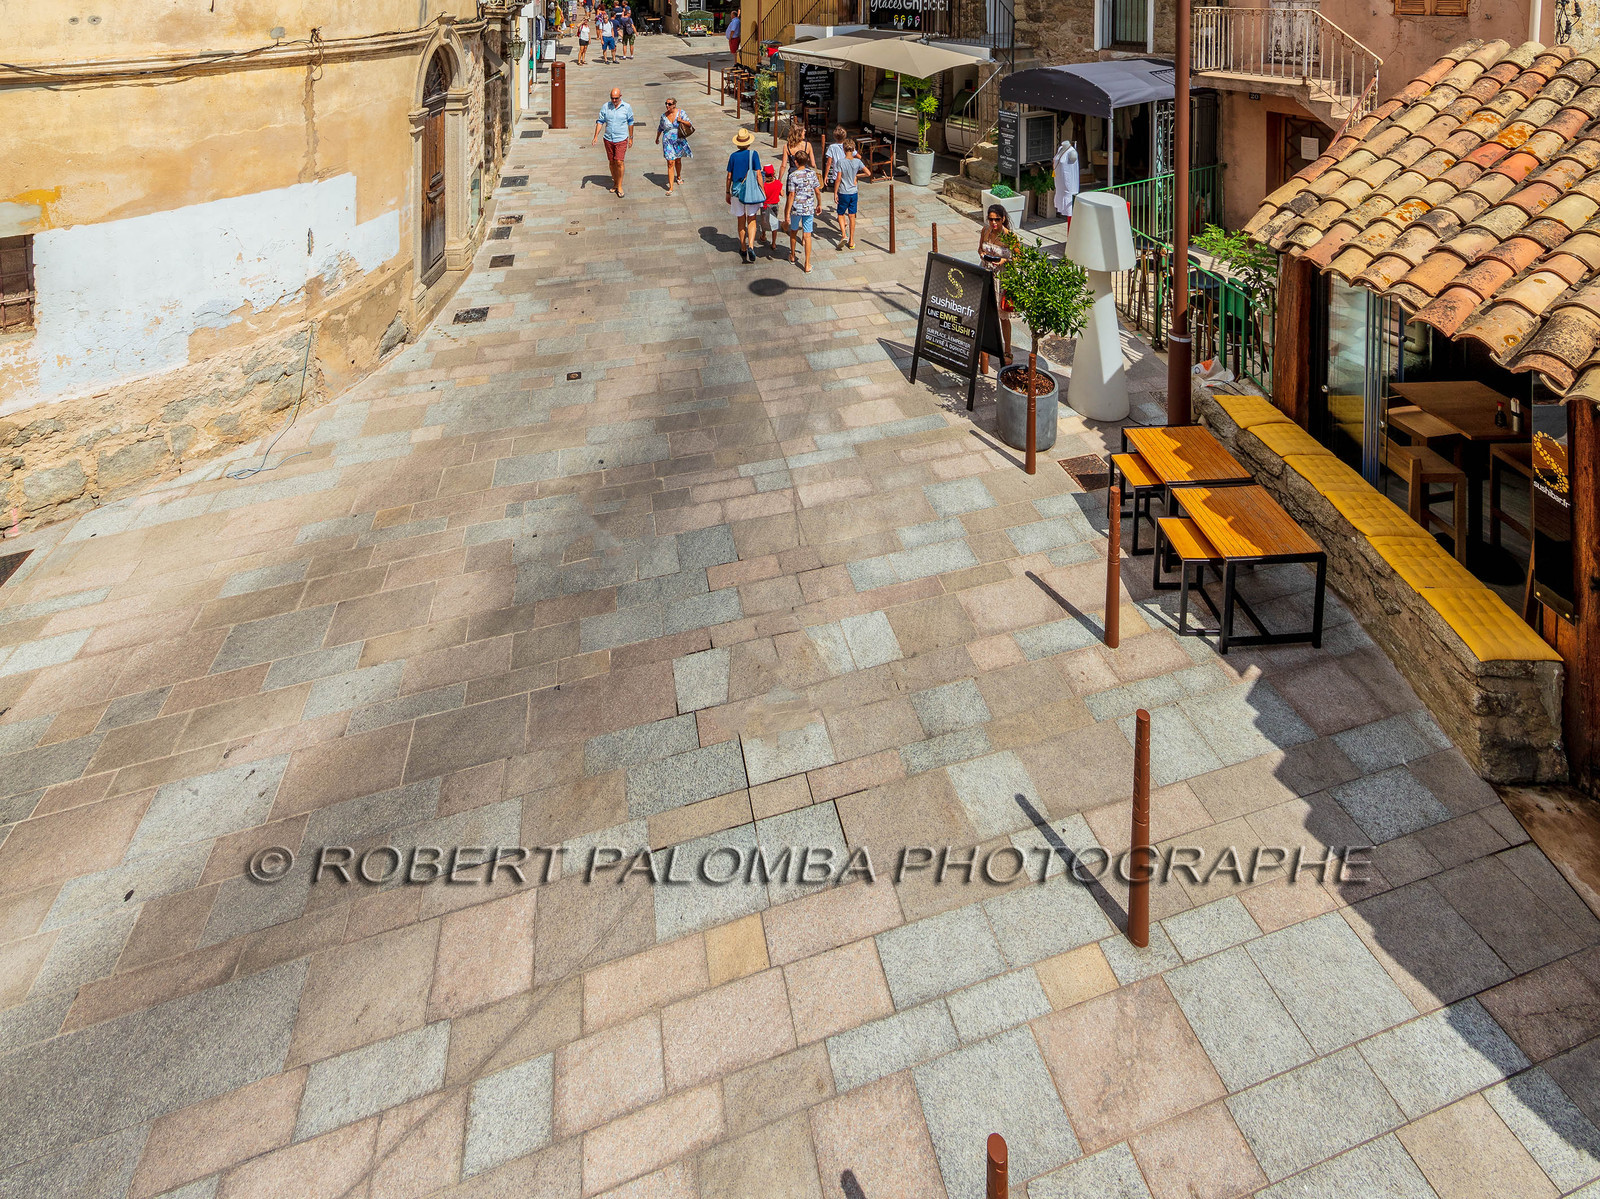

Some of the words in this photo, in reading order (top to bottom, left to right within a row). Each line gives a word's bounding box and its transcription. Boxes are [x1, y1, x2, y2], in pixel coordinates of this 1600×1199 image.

[927, 308, 939, 318] UNE
[930, 295, 975, 317] sushibar.fr
[951, 323, 971, 336] SUSHI
[1533, 480, 1571, 508] sushibar.fr
